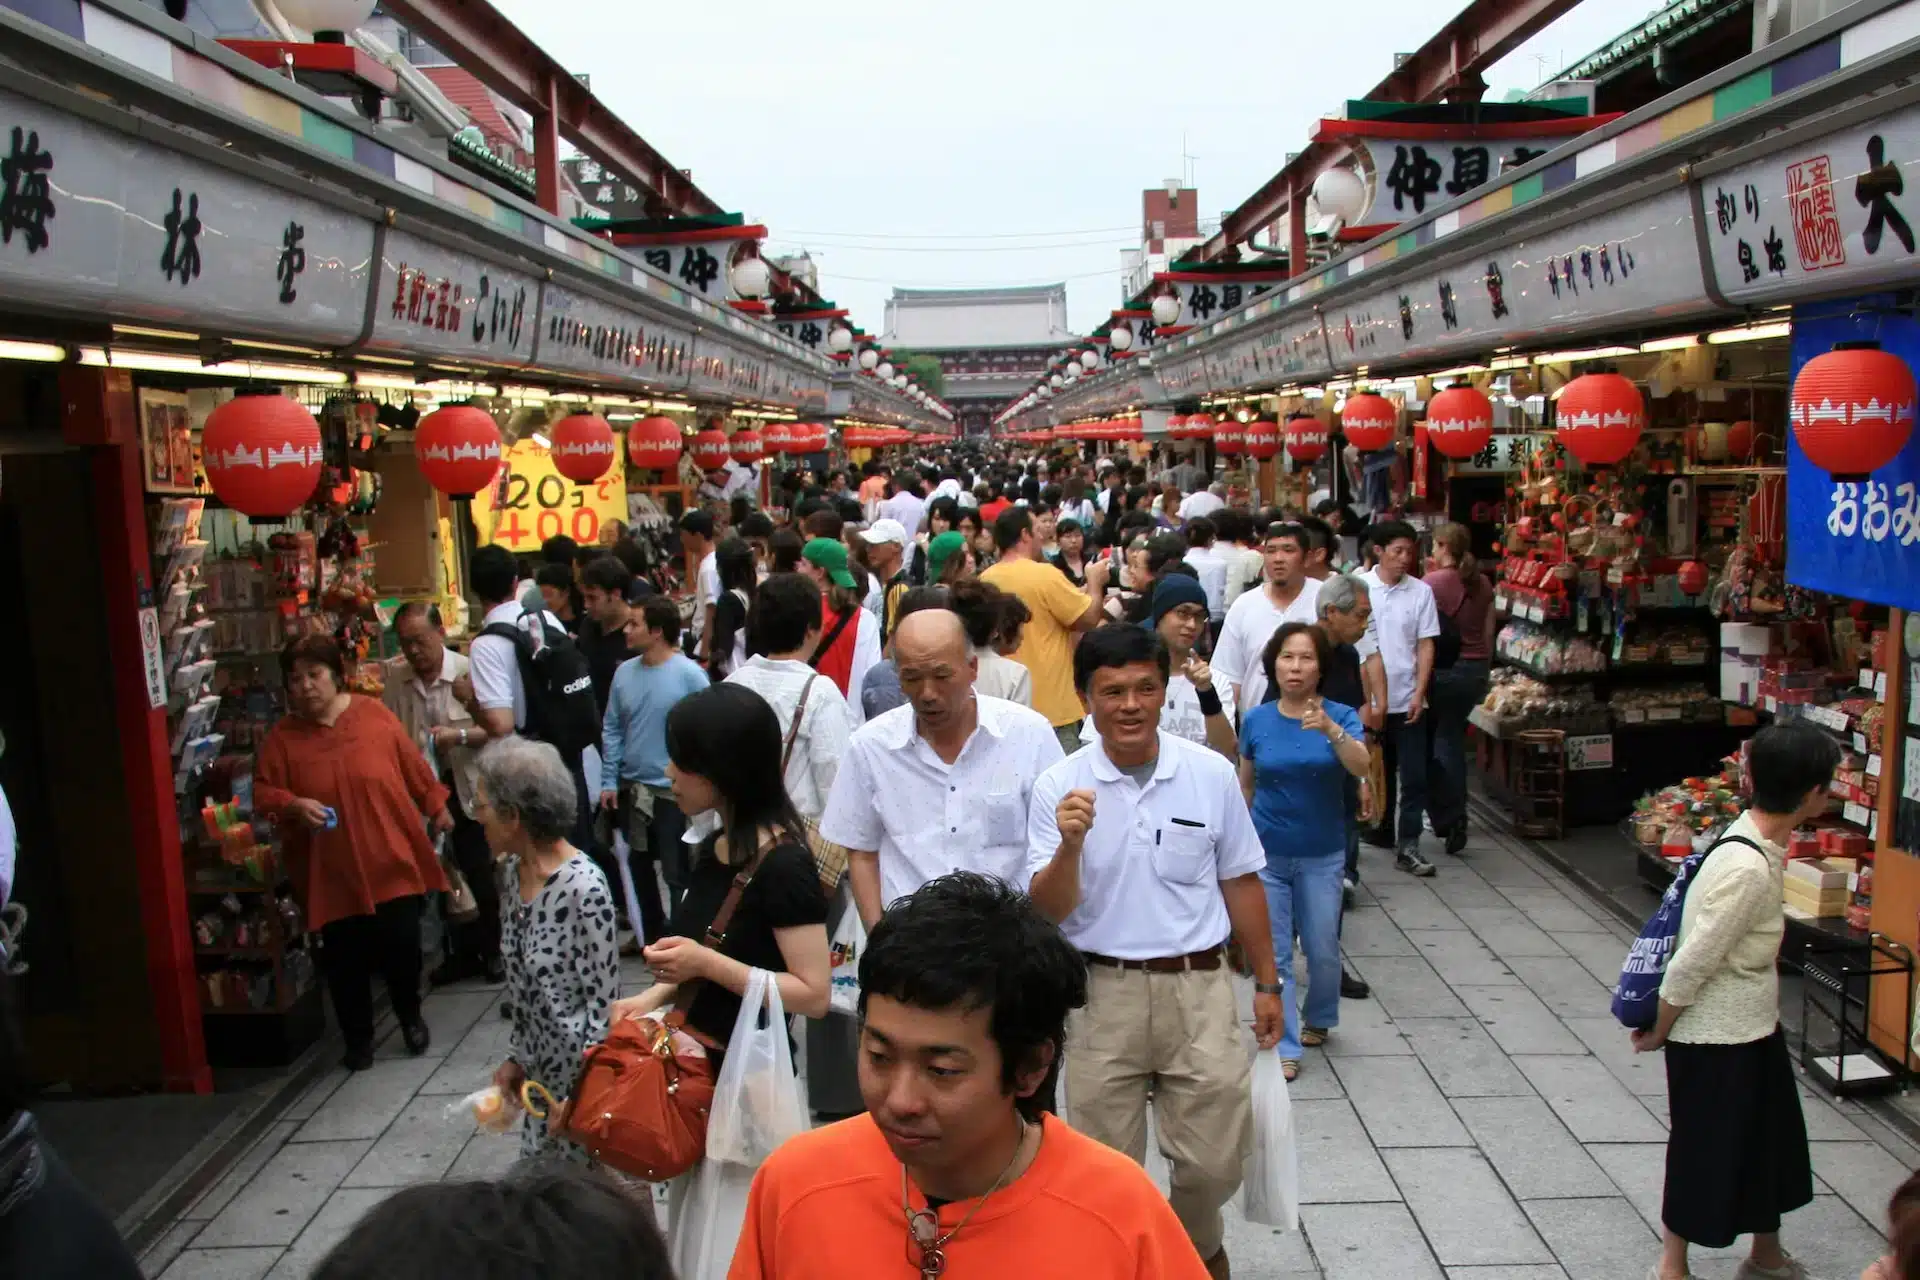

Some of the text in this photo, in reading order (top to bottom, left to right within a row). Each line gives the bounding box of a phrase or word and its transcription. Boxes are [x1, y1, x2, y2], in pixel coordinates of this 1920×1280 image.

[1, 126, 304, 304] 梅林堂
[1715, 184, 1760, 236] 削り
[1856, 135, 1915, 254] 大
[1738, 224, 1786, 284] 昆布
